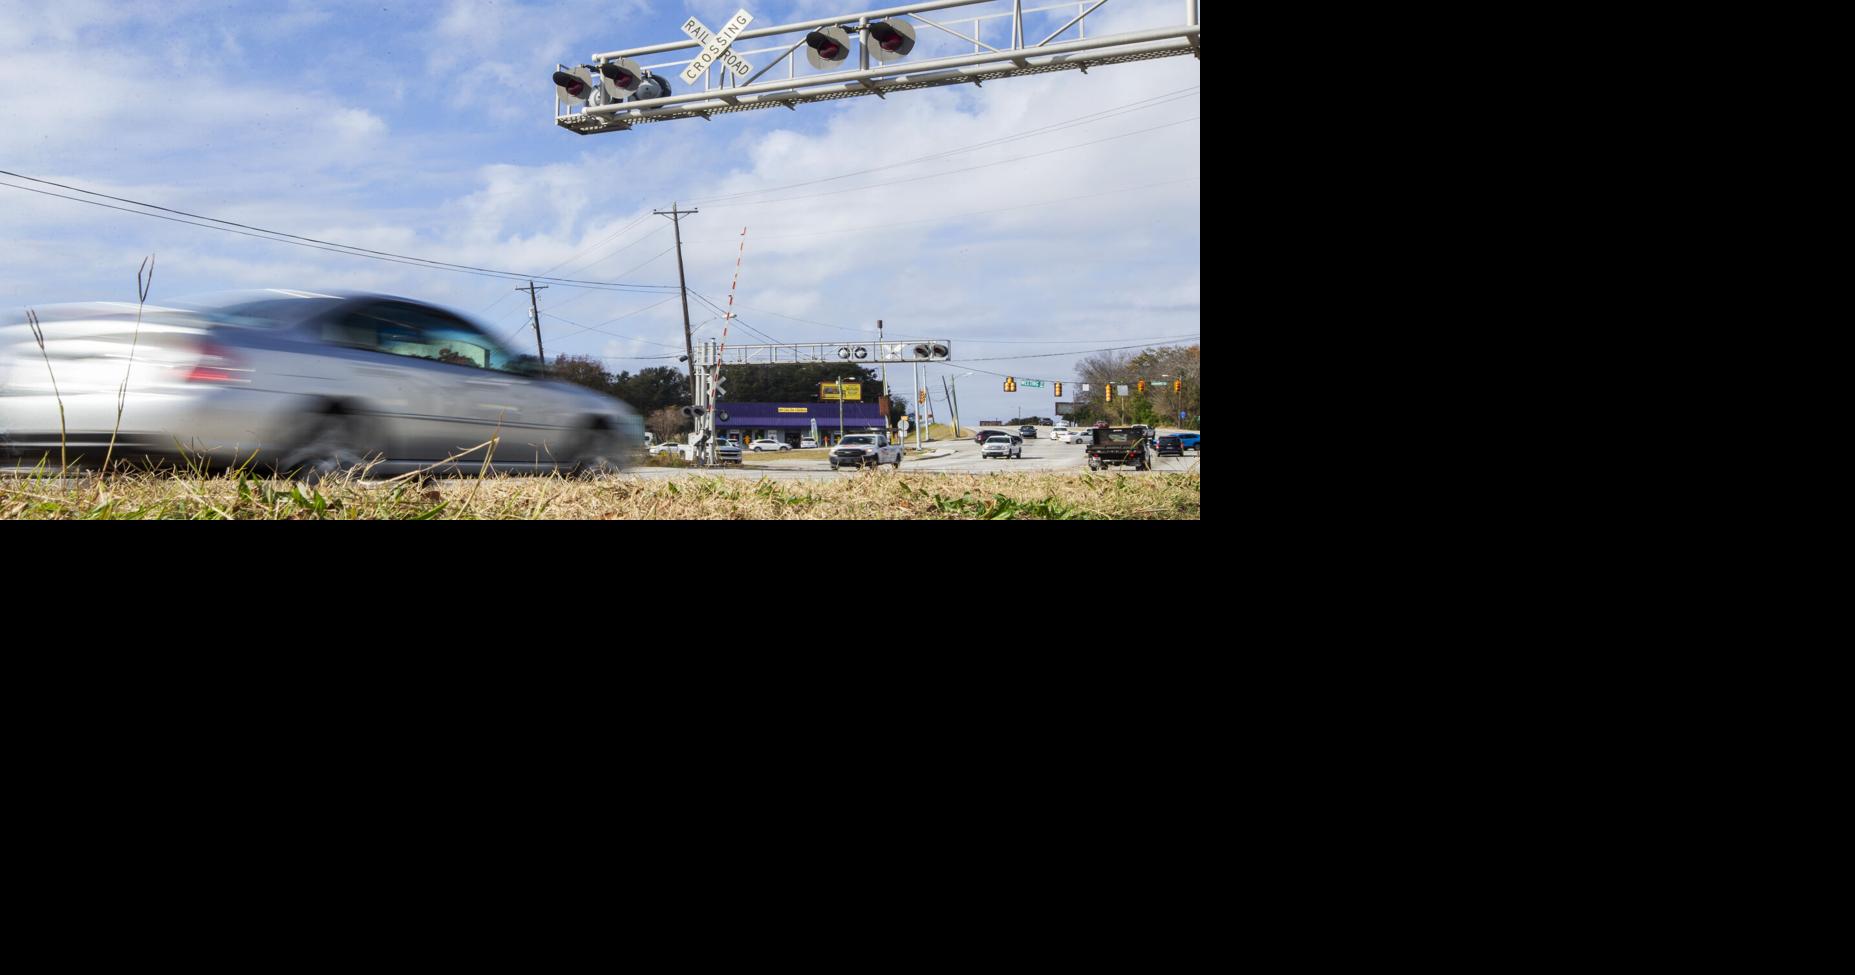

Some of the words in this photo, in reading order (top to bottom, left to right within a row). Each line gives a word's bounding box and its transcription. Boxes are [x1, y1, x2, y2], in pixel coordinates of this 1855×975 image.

[685, 20, 709, 45] RAIL
[722, 49, 749, 76] ROAD
[686, 15, 747, 79] CROSSING
